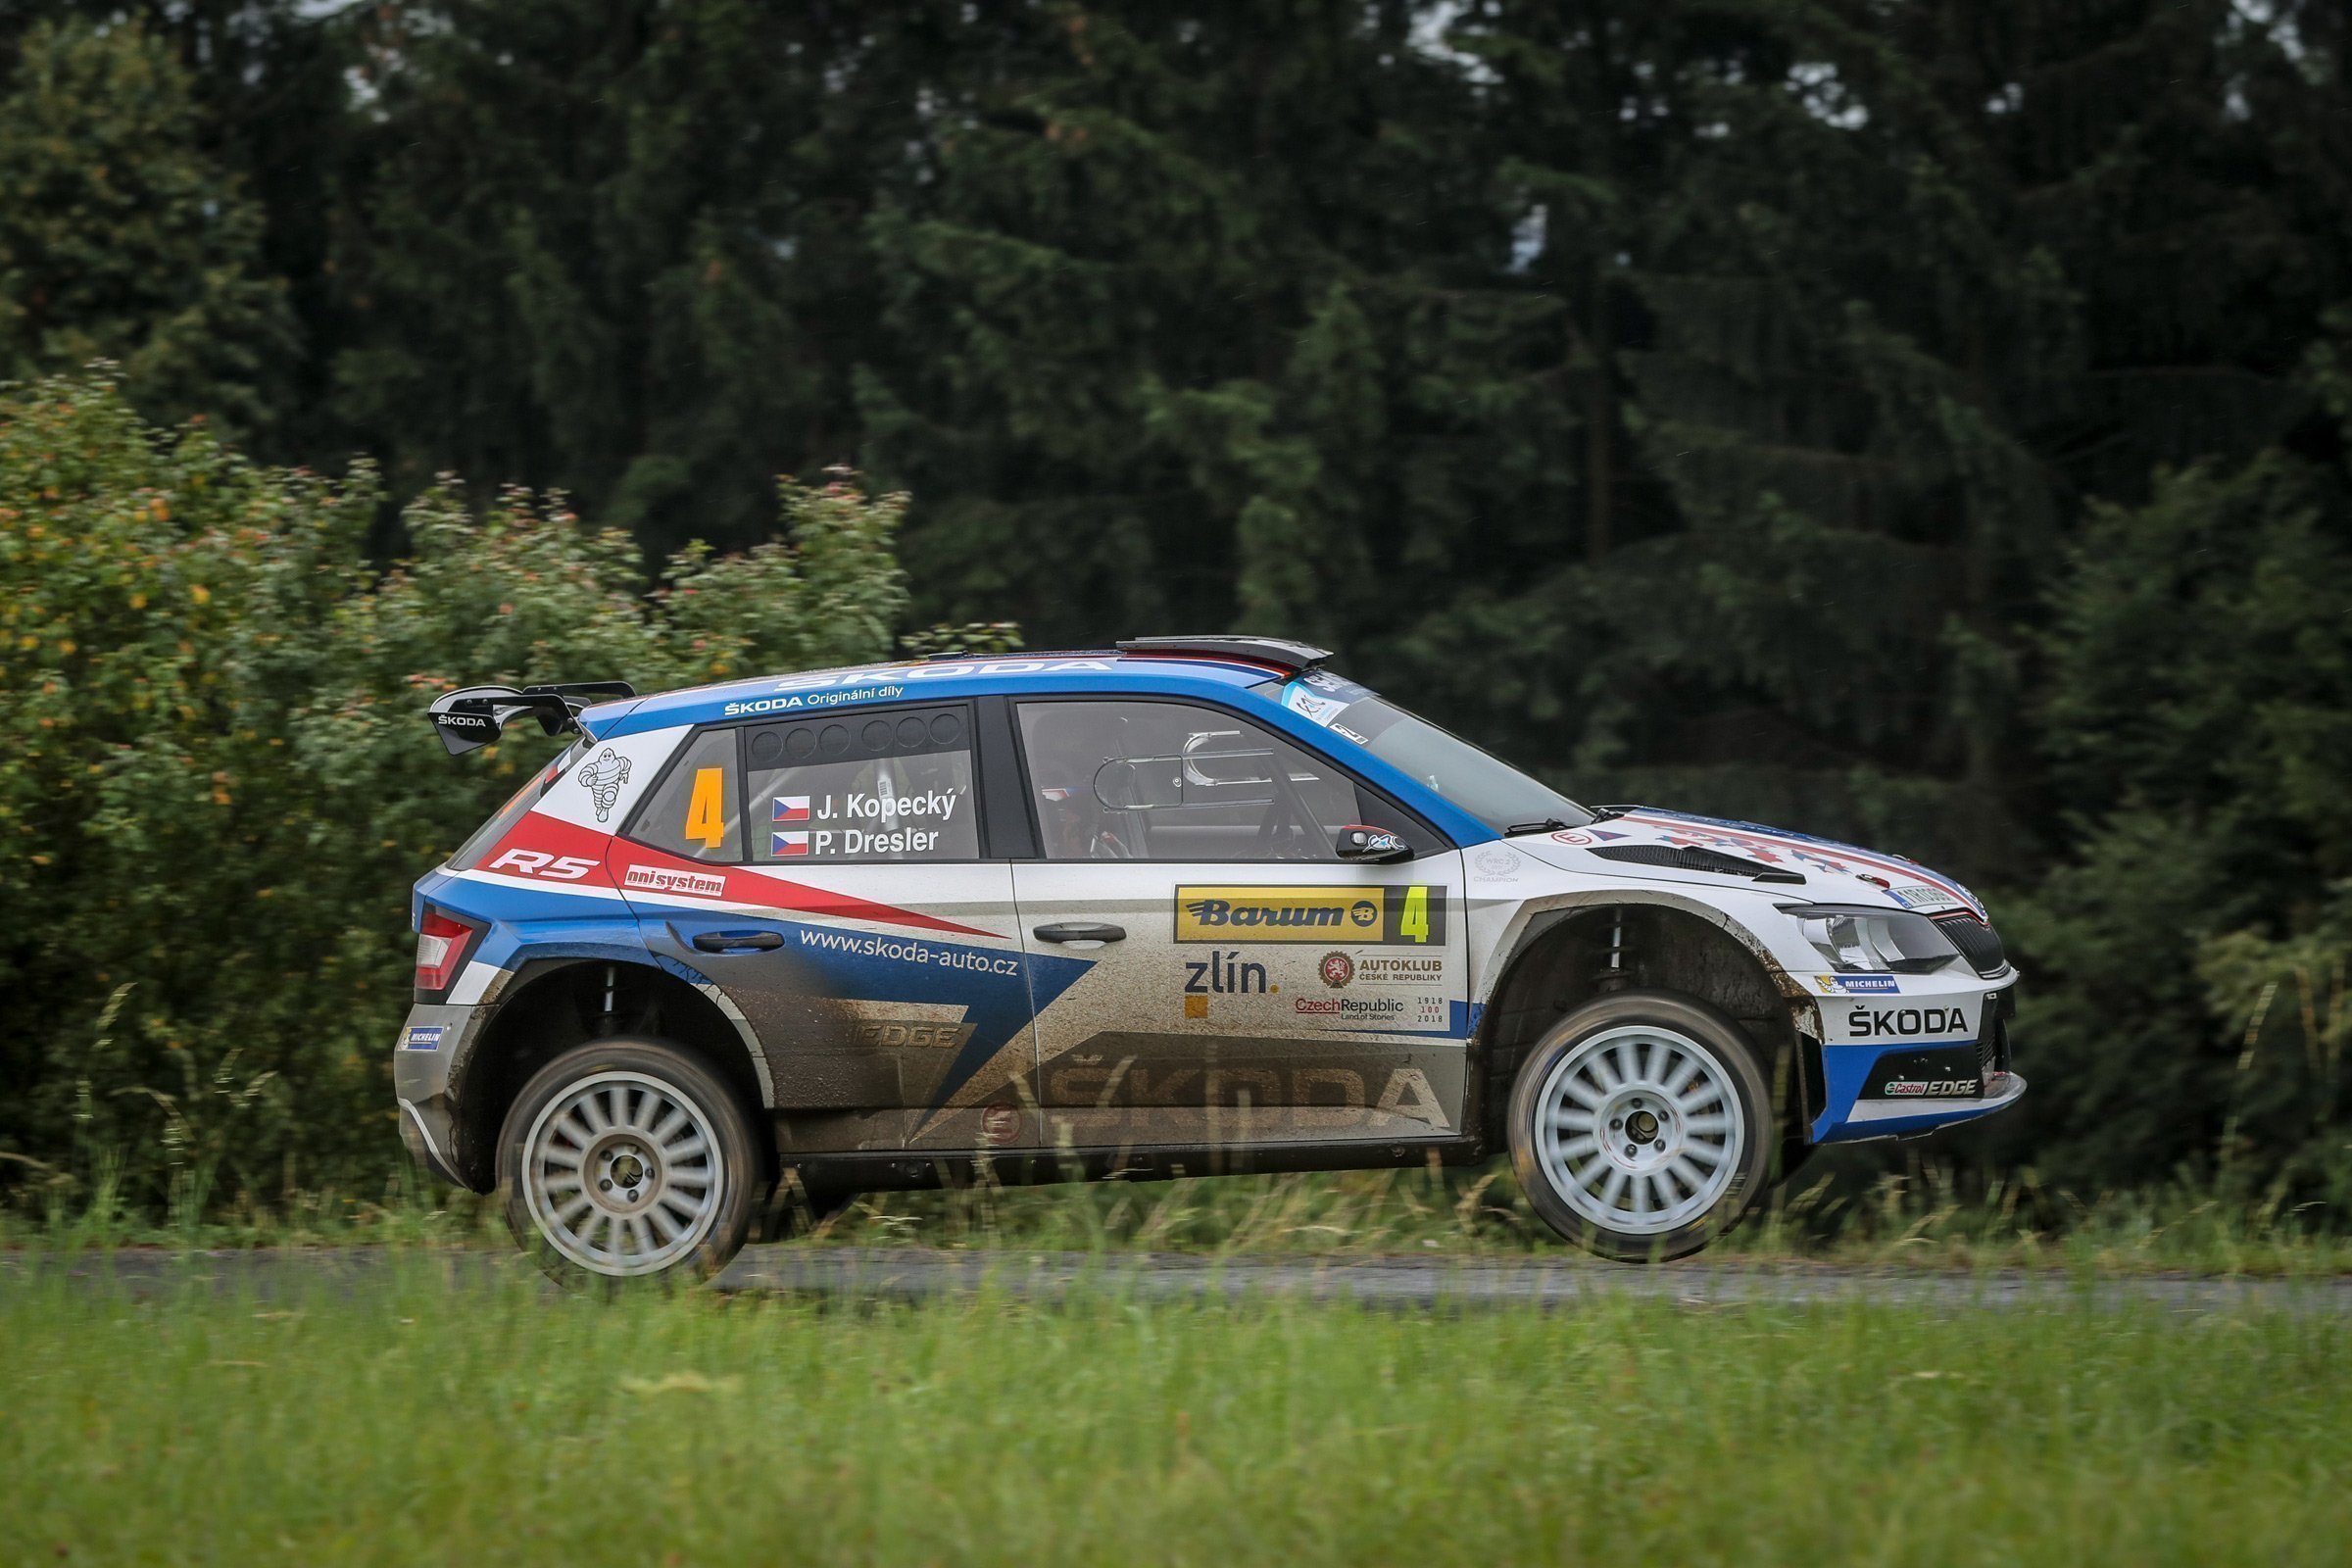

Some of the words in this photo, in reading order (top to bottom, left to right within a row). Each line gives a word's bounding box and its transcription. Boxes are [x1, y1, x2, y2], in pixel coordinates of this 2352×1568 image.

[724, 696, 804, 715] ŠKODA
[807, 687, 875, 707] Originální
[877, 685, 904, 701] díly
[437, 713, 487, 728] ŠKODA
[685, 767, 724, 849] 4
[816, 794, 839, 820] J.
[847, 788, 957, 823] Kopecký
[814, 833, 835, 856] P.
[844, 828, 939, 855] Dresler
[488, 848, 601, 880] R5
[1185, 899, 1345, 927] Barum
[1400, 886, 1429, 943] 4
[800, 928, 1018, 977] www.skoda-auto.cz
[1359, 959, 1443, 972] AUTOKLUB
[1393, 973, 1443, 982] REPUBLIKY
[1848, 1004, 1969, 1038] ŠKODA
[410, 1033, 441, 1042] MICHELIN
[857, 1025, 962, 1050] EDGE
[1894, 1082, 1926, 1094] Castrol
[1926, 1079, 1979, 1096] EDGE
